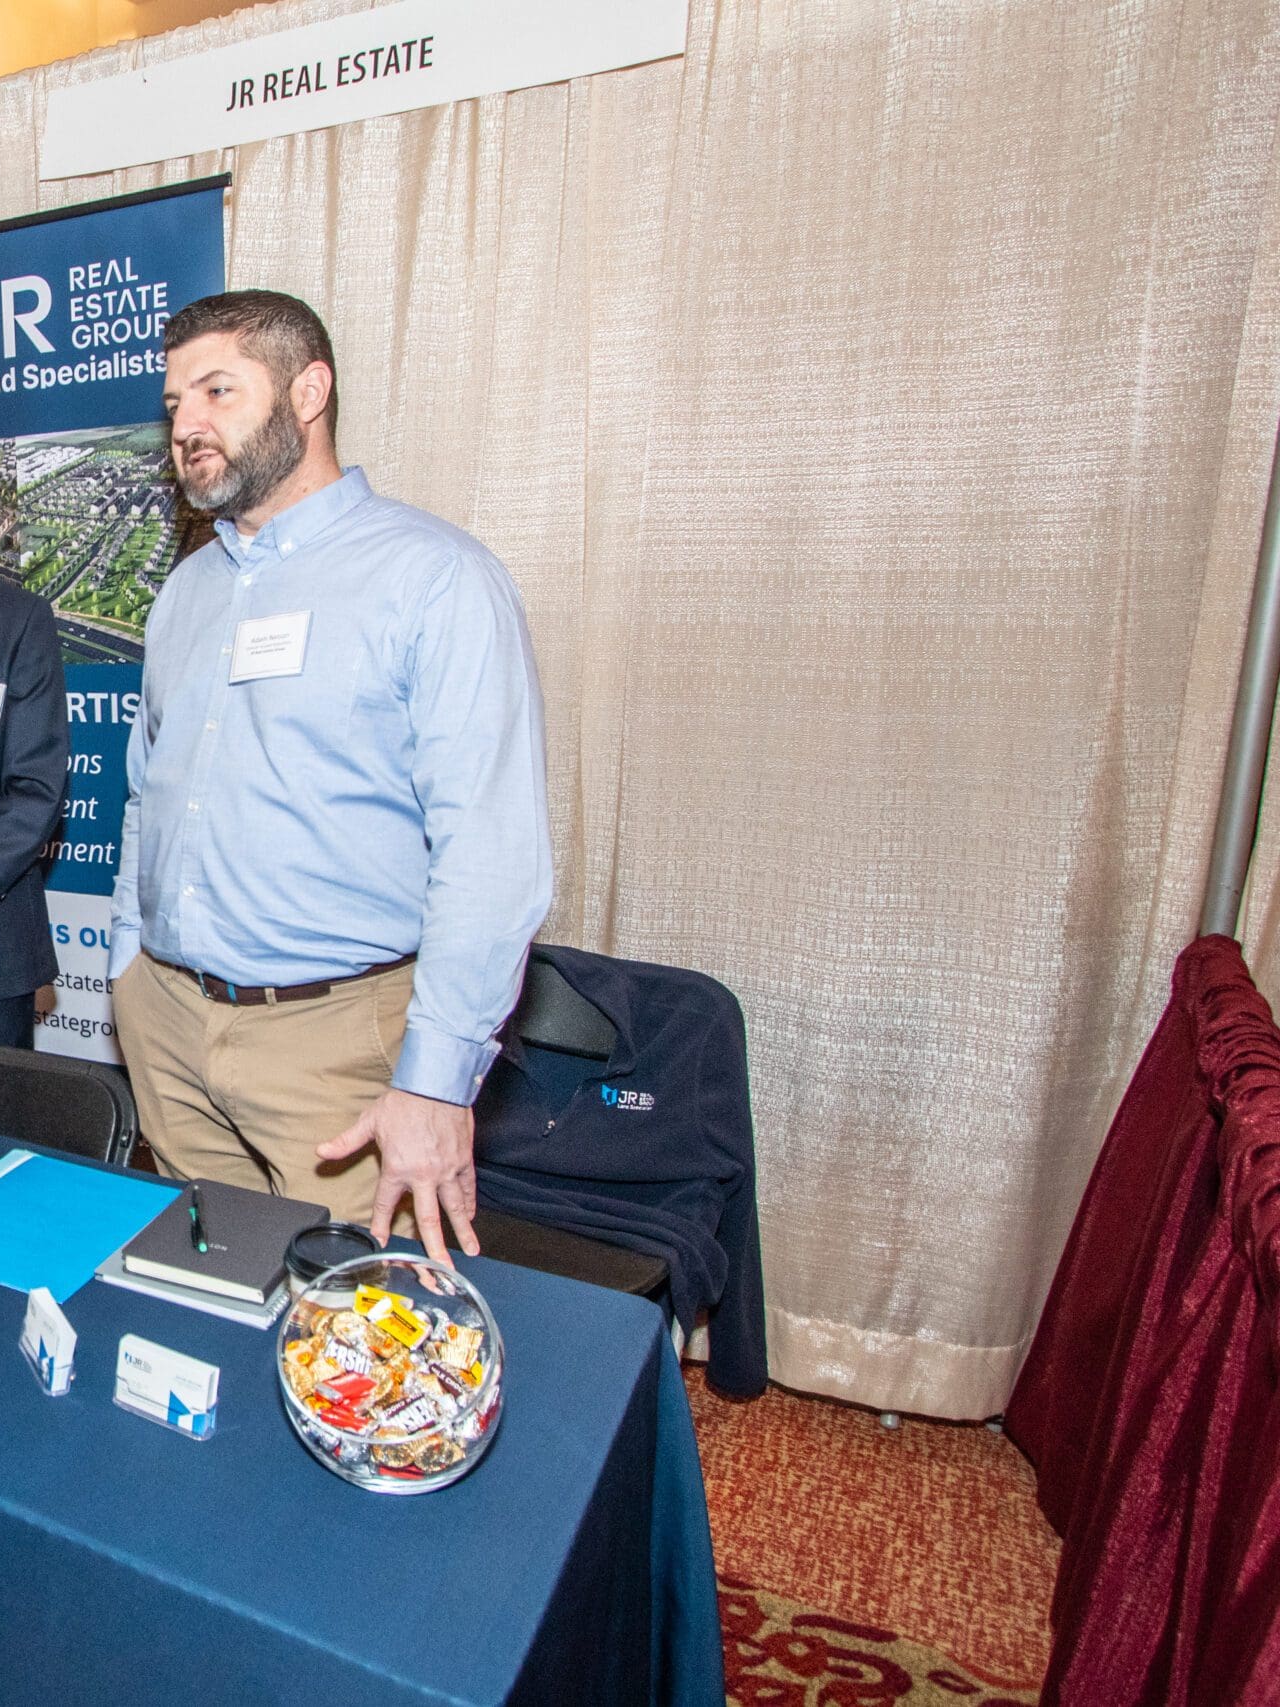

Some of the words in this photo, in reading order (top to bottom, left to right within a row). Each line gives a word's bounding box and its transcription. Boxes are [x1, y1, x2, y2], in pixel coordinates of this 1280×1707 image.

[226, 78, 255, 112] JR
[262, 61, 328, 104] REAL
[336, 36, 434, 87] ESTATE
[69, 256, 138, 292] REAL
[70, 282, 168, 322] ESTATE
[71, 311, 171, 349] GROUP
[23, 349, 168, 390] Specialists
[618, 1090, 638, 1105] JR
